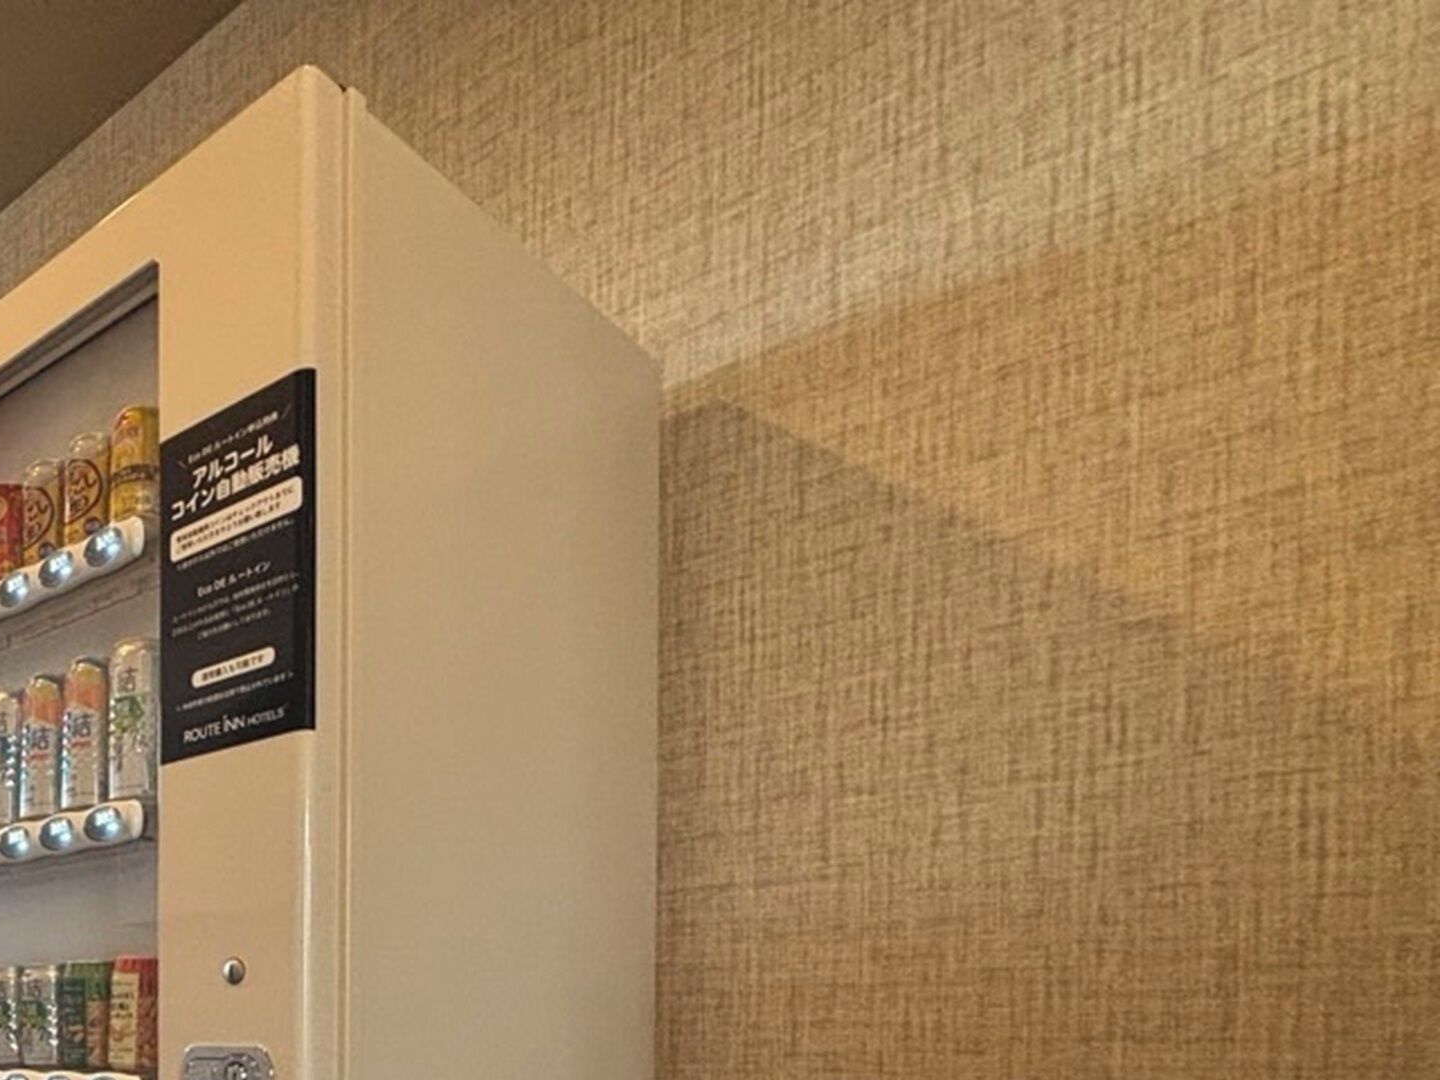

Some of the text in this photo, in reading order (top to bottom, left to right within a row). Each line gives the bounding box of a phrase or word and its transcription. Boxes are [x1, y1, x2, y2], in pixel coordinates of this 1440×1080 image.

[171, 443, 300, 521] コイン自動販売機
[192, 434, 274, 489] アルコール
[183, 721, 222, 743] ROUTE
[247, 707, 285, 726] HOTELS
